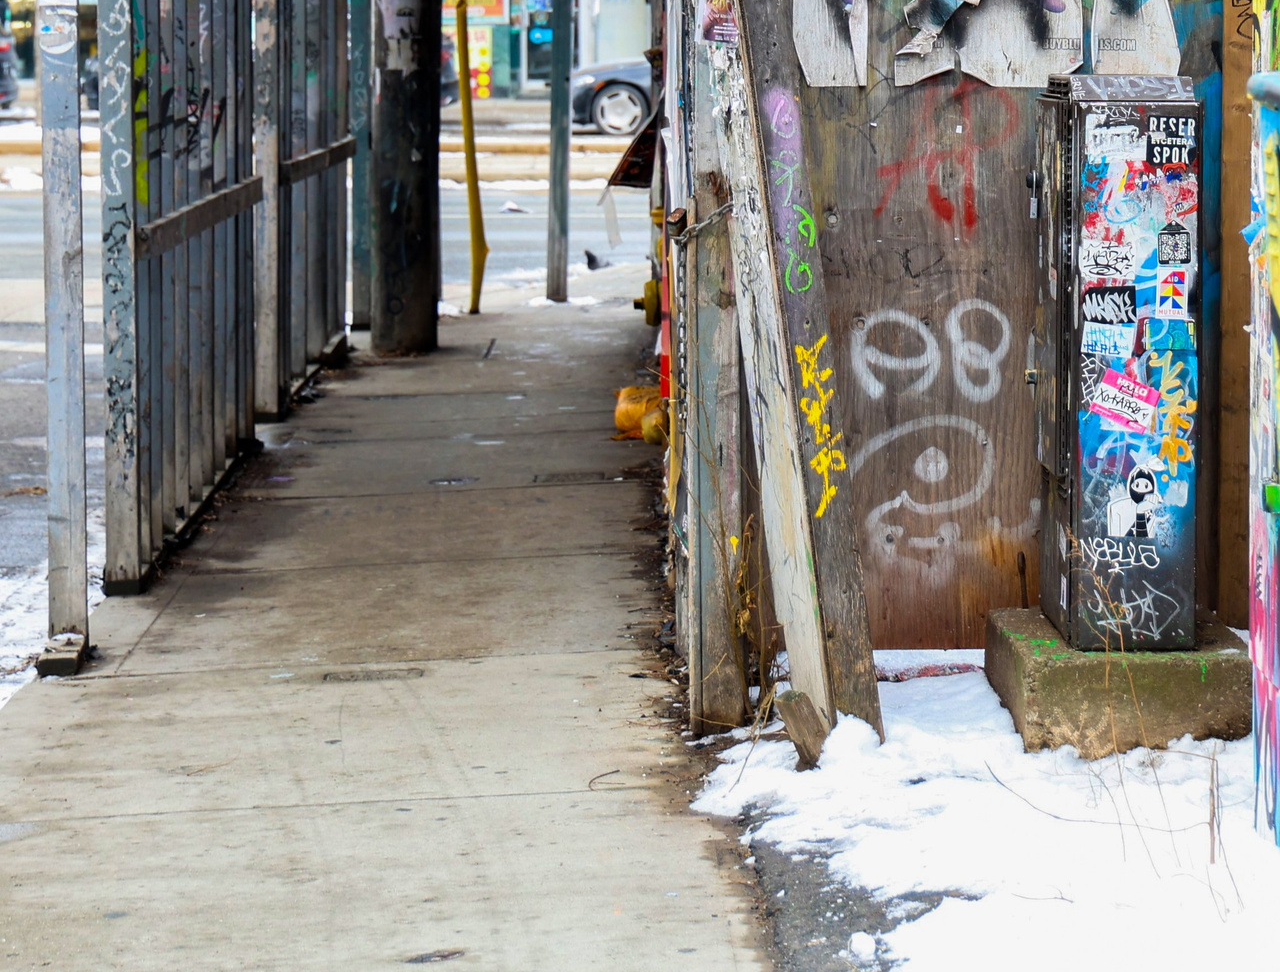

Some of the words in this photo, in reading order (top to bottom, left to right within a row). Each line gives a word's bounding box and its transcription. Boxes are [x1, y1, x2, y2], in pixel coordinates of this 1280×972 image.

[1149, 116, 1197, 137] RESER
[1151, 137, 1194, 147] ETCETERA
[1153, 146, 1190, 165] SPOK
[1158, 308, 1185, 317] MUTUAL
